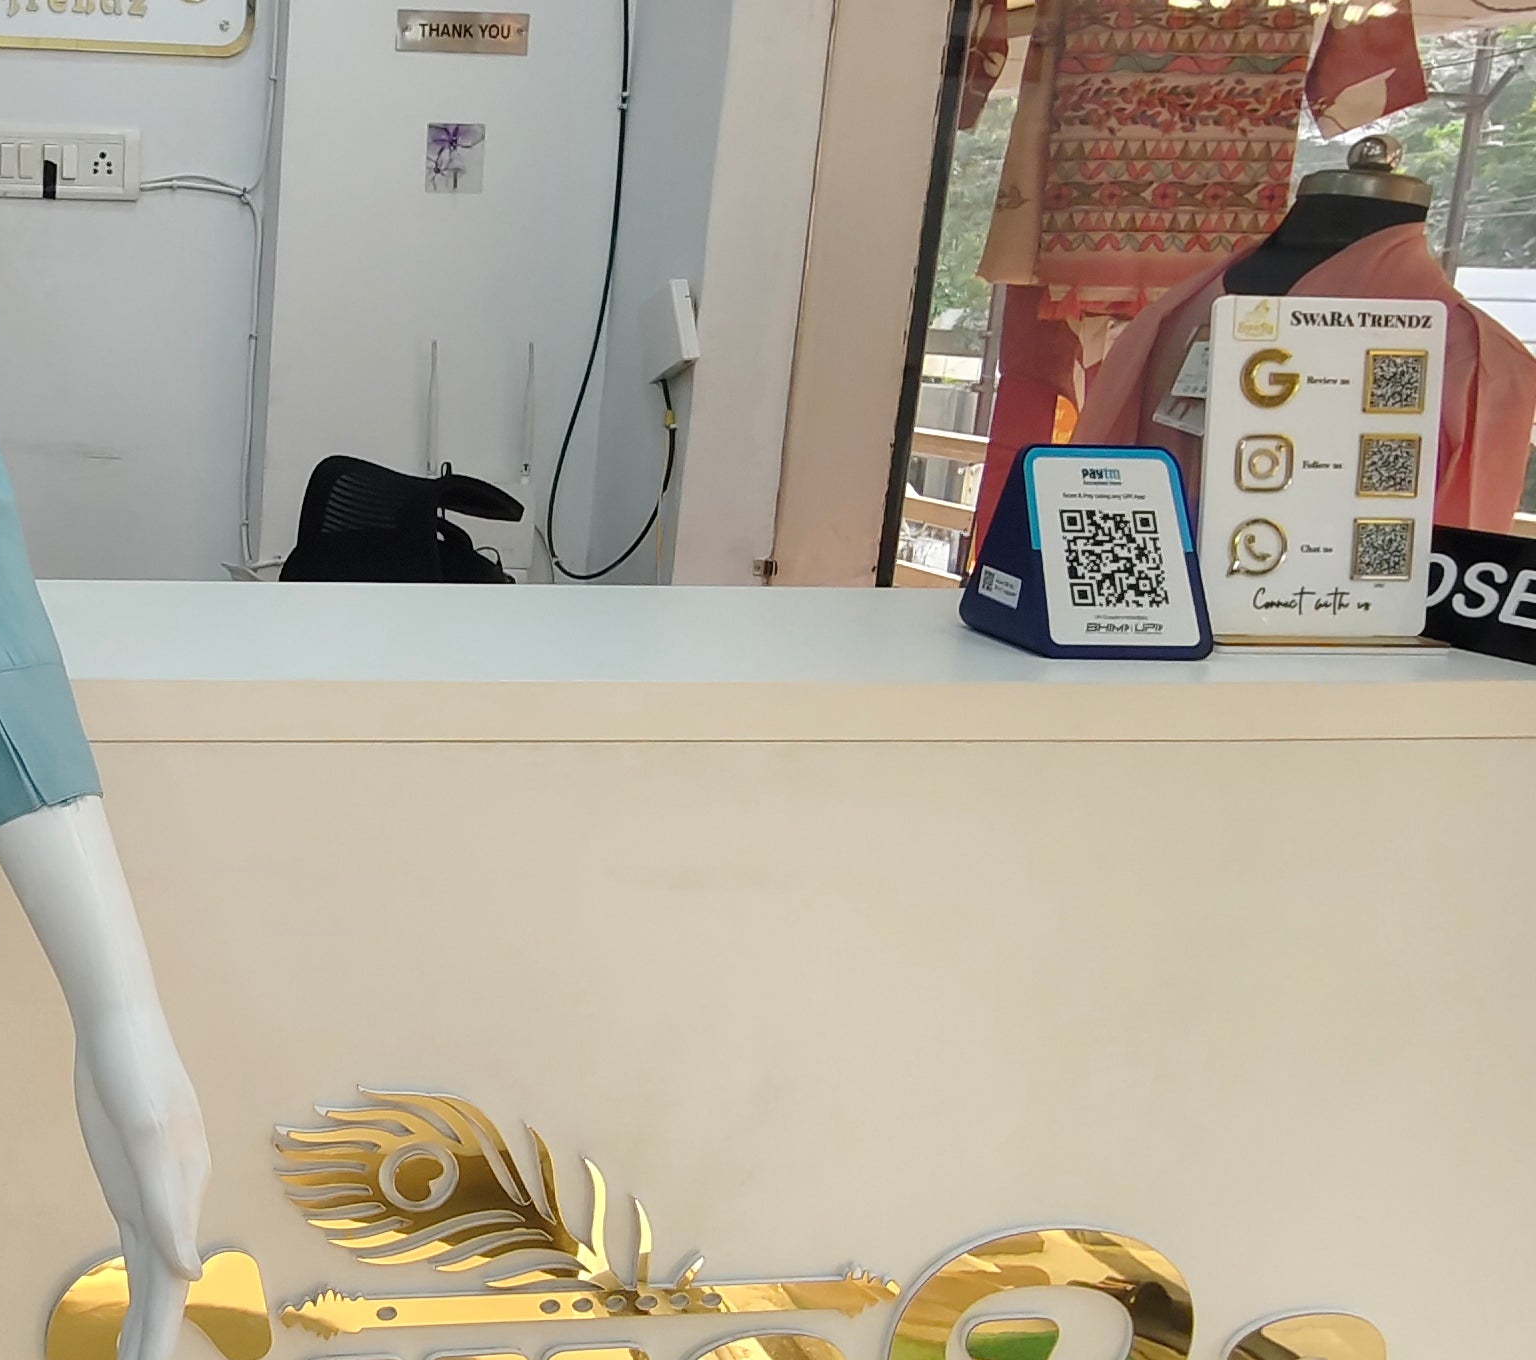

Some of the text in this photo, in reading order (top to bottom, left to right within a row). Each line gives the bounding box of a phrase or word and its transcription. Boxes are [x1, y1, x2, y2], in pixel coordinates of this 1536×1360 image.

[418, 22, 511, 40] THANK YOU
[1305, 375, 1338, 386] Review
[1301, 459, 1330, 470] Follow
[1300, 544, 1321, 554] Chat
